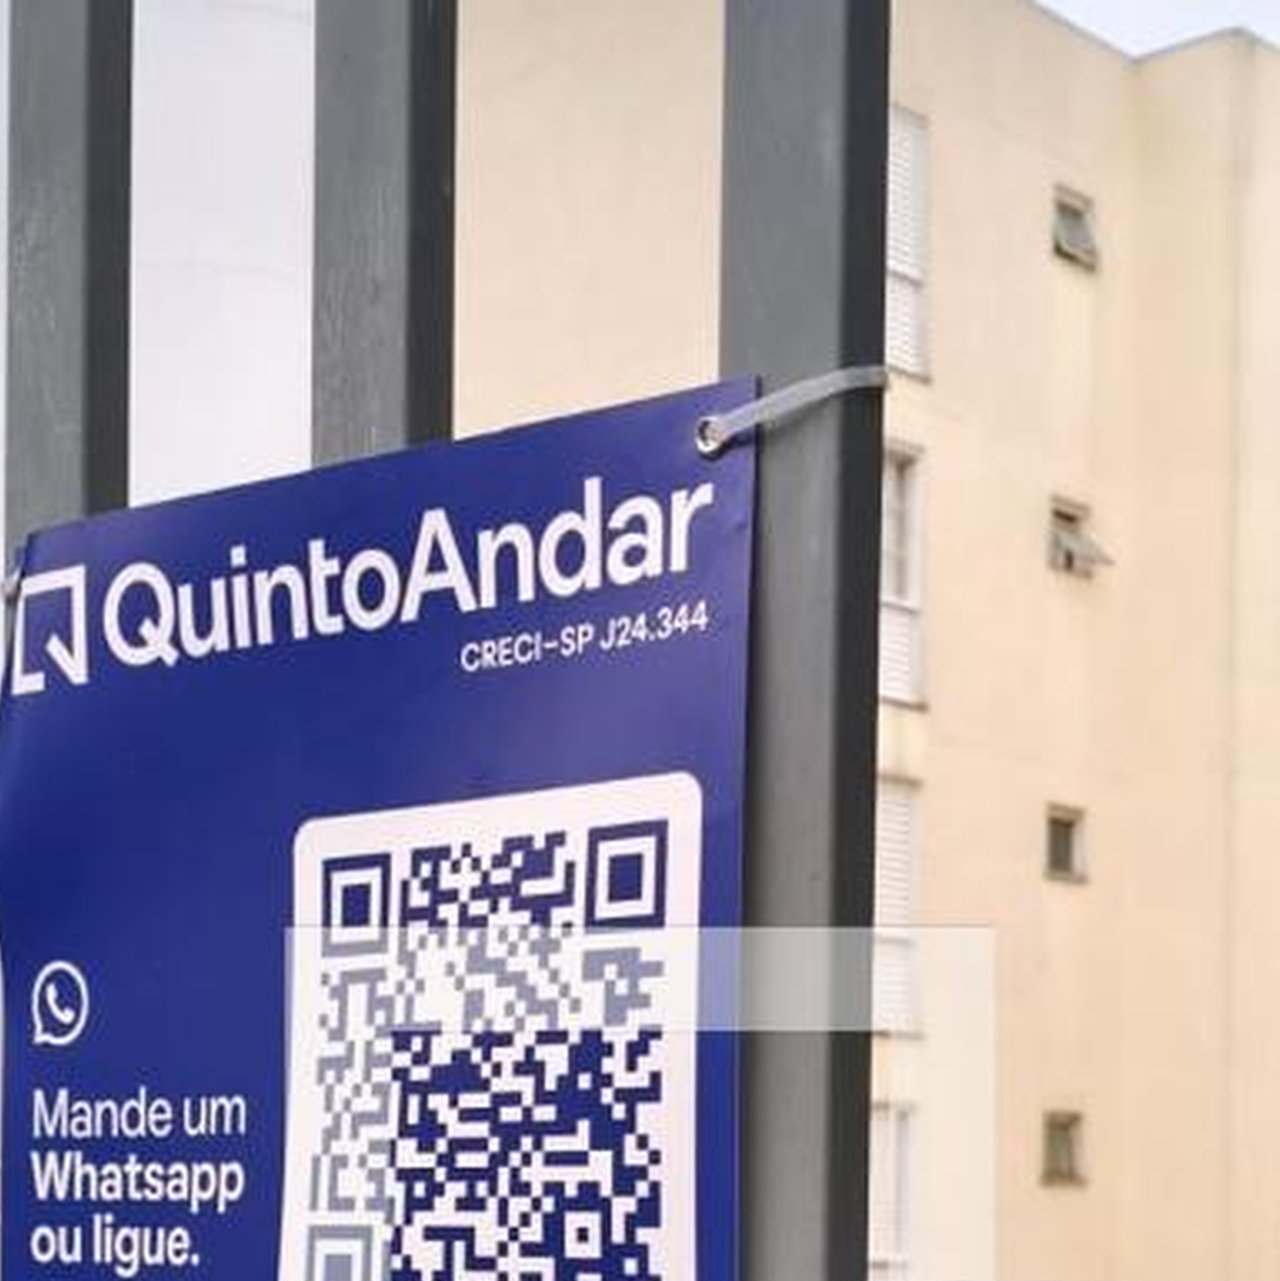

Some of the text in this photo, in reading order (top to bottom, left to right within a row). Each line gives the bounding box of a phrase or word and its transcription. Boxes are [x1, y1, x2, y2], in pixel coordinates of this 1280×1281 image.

[103, 476, 713, 667] QuintoAndar
[460, 600, 709, 673] CRECI-SP J24.344
[33, 1085, 247, 1139] Mande um
[30, 1150, 245, 1215] Whatsapp
[30, 1212, 200, 1279] ou ligue.
